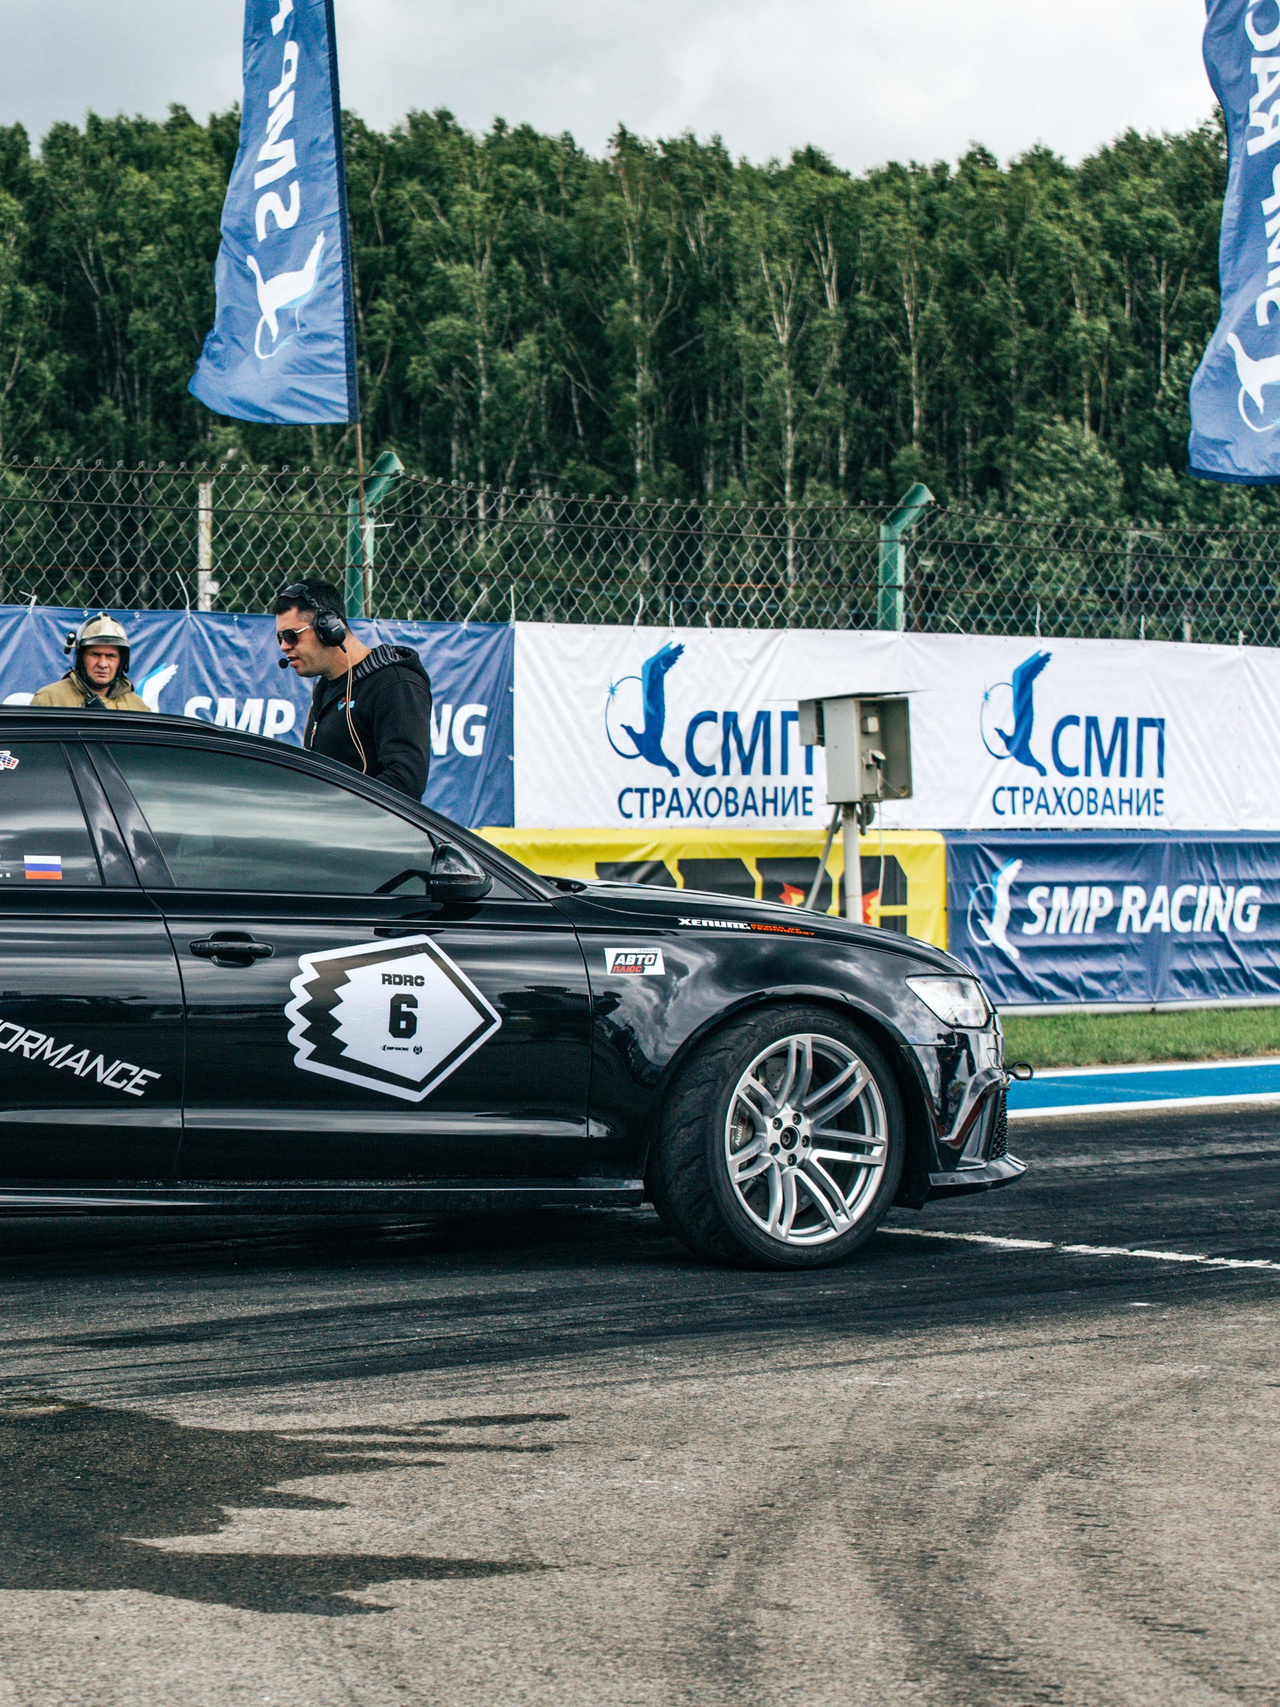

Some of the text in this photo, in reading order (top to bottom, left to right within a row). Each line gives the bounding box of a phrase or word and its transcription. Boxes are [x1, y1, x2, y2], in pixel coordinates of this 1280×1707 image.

[685, 710, 814, 777] СМП
[1051, 714, 1166, 778] СМП
[618, 786, 813, 820] СТРАХОВАНИЕ
[992, 786, 1165, 816] СТРАХОВАНИЕ
[1022, 885, 1262, 935] SMP RACING
[612, 965, 643, 973] ПЛЮС
[614, 954, 656, 966] АВТО
[381, 973, 425, 987] RDRC
[388, 993, 419, 1039] 6
